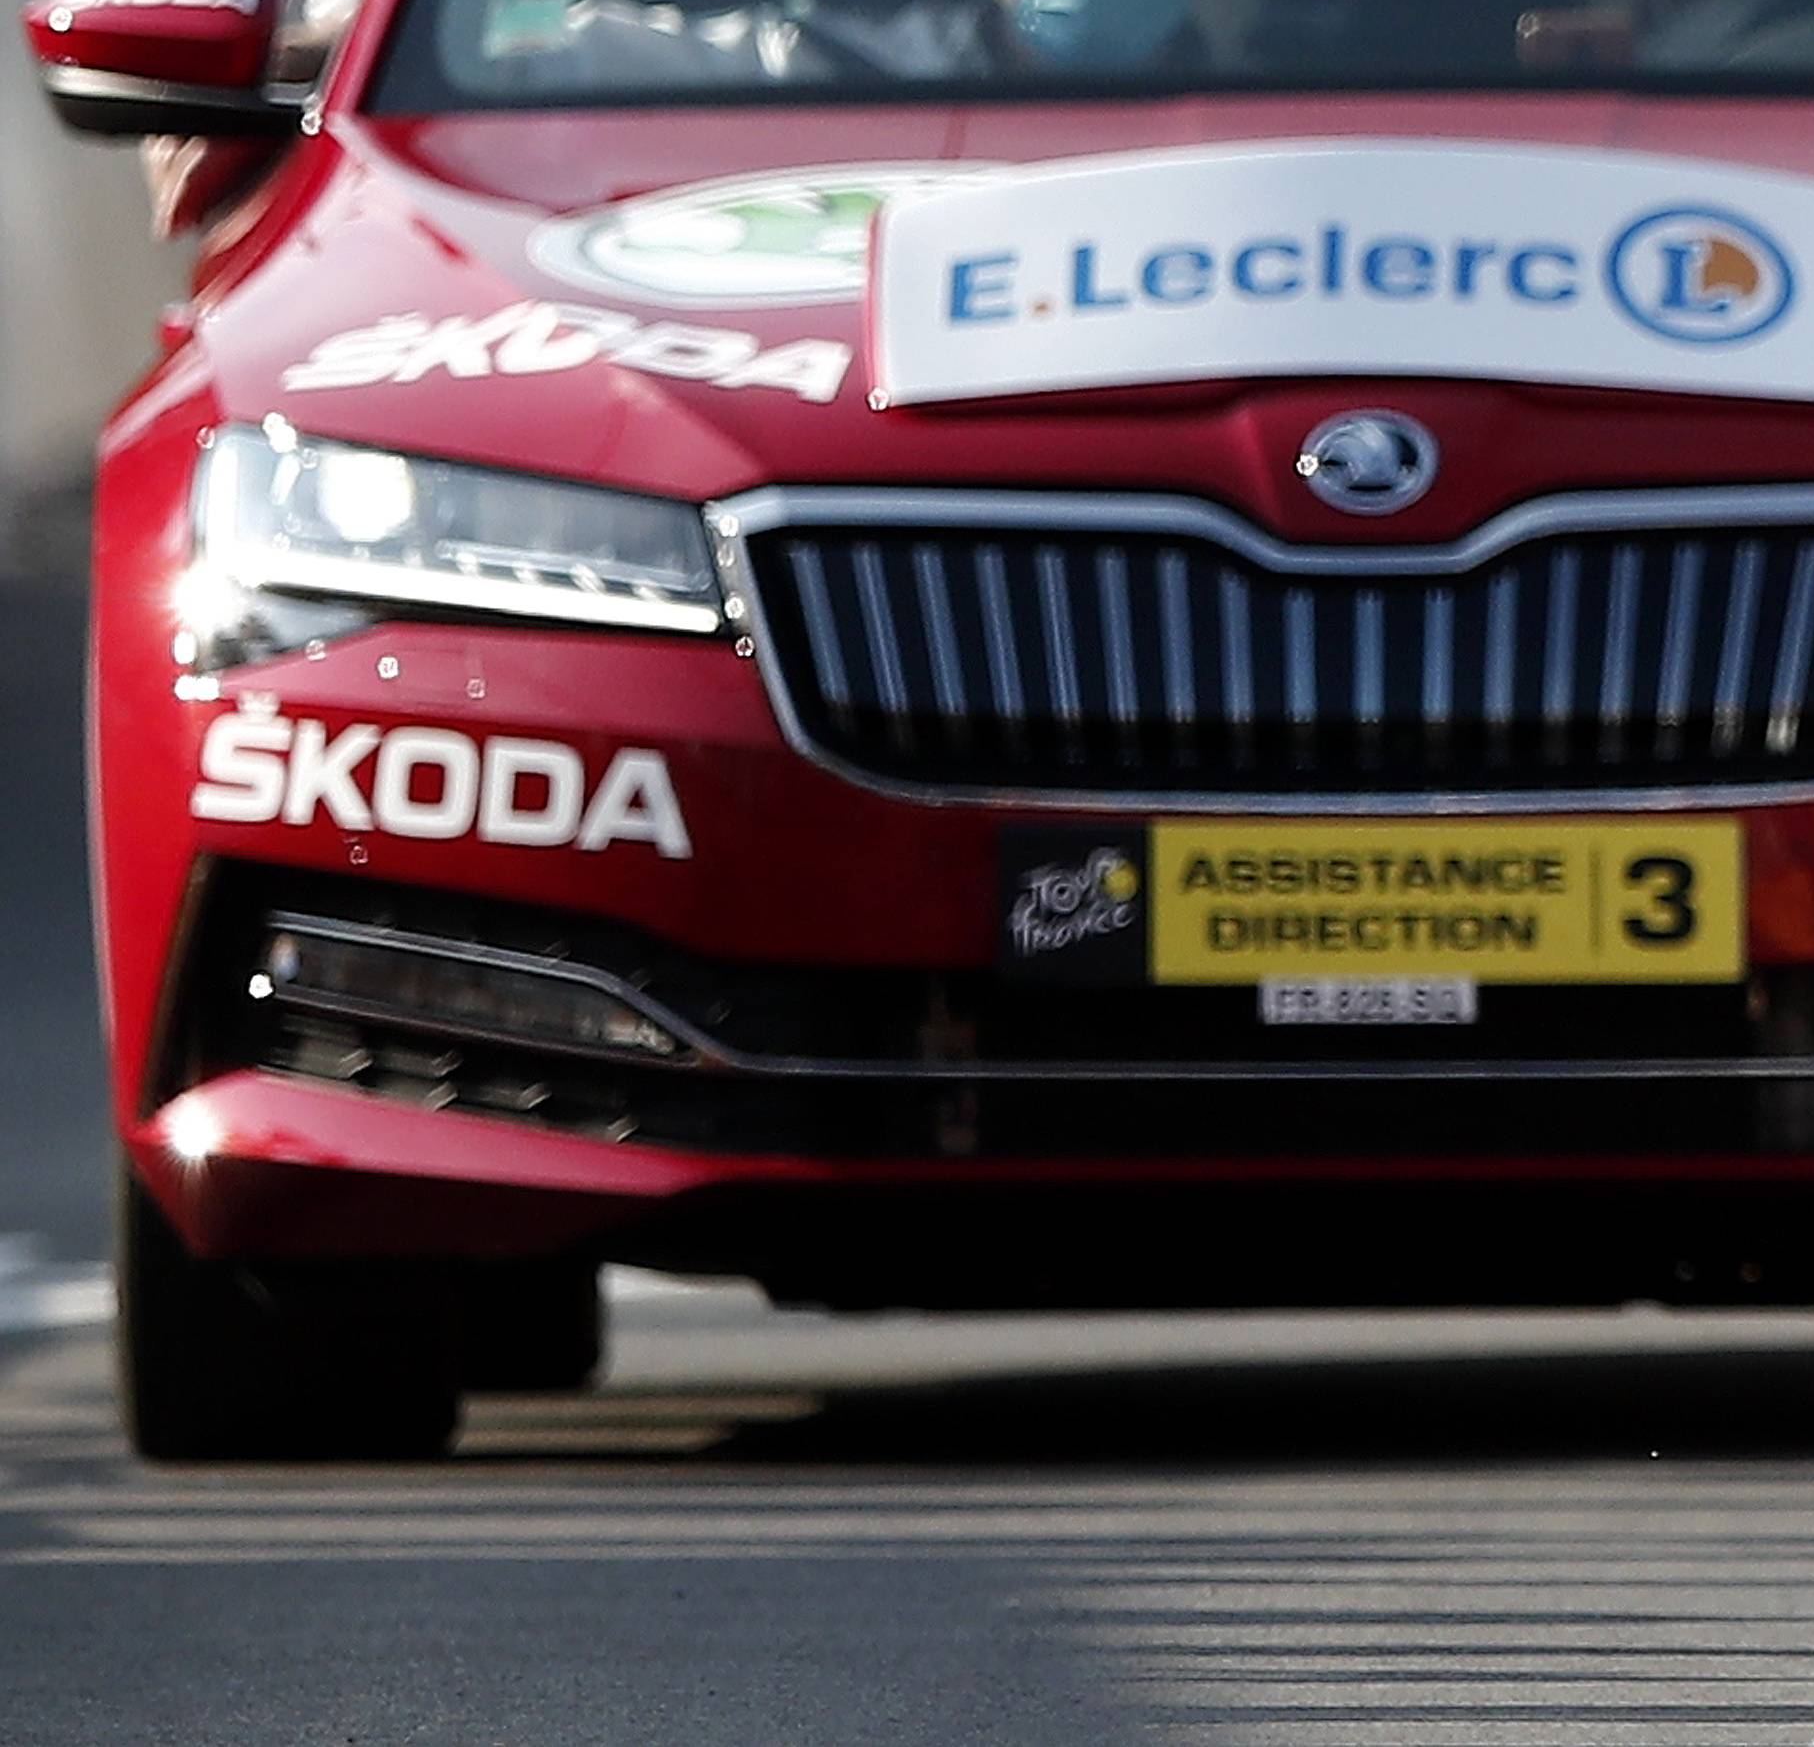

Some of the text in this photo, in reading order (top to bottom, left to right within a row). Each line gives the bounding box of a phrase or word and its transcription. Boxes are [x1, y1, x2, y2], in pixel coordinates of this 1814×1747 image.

[946, 223, 1581, 327] E.Leclerc
[189, 688, 695, 860] ŠKODA
[1181, 850, 1568, 895] ASSISTANCE
[1622, 854, 1698, 948] 3
[1208, 907, 1538, 952] DIRECTION
